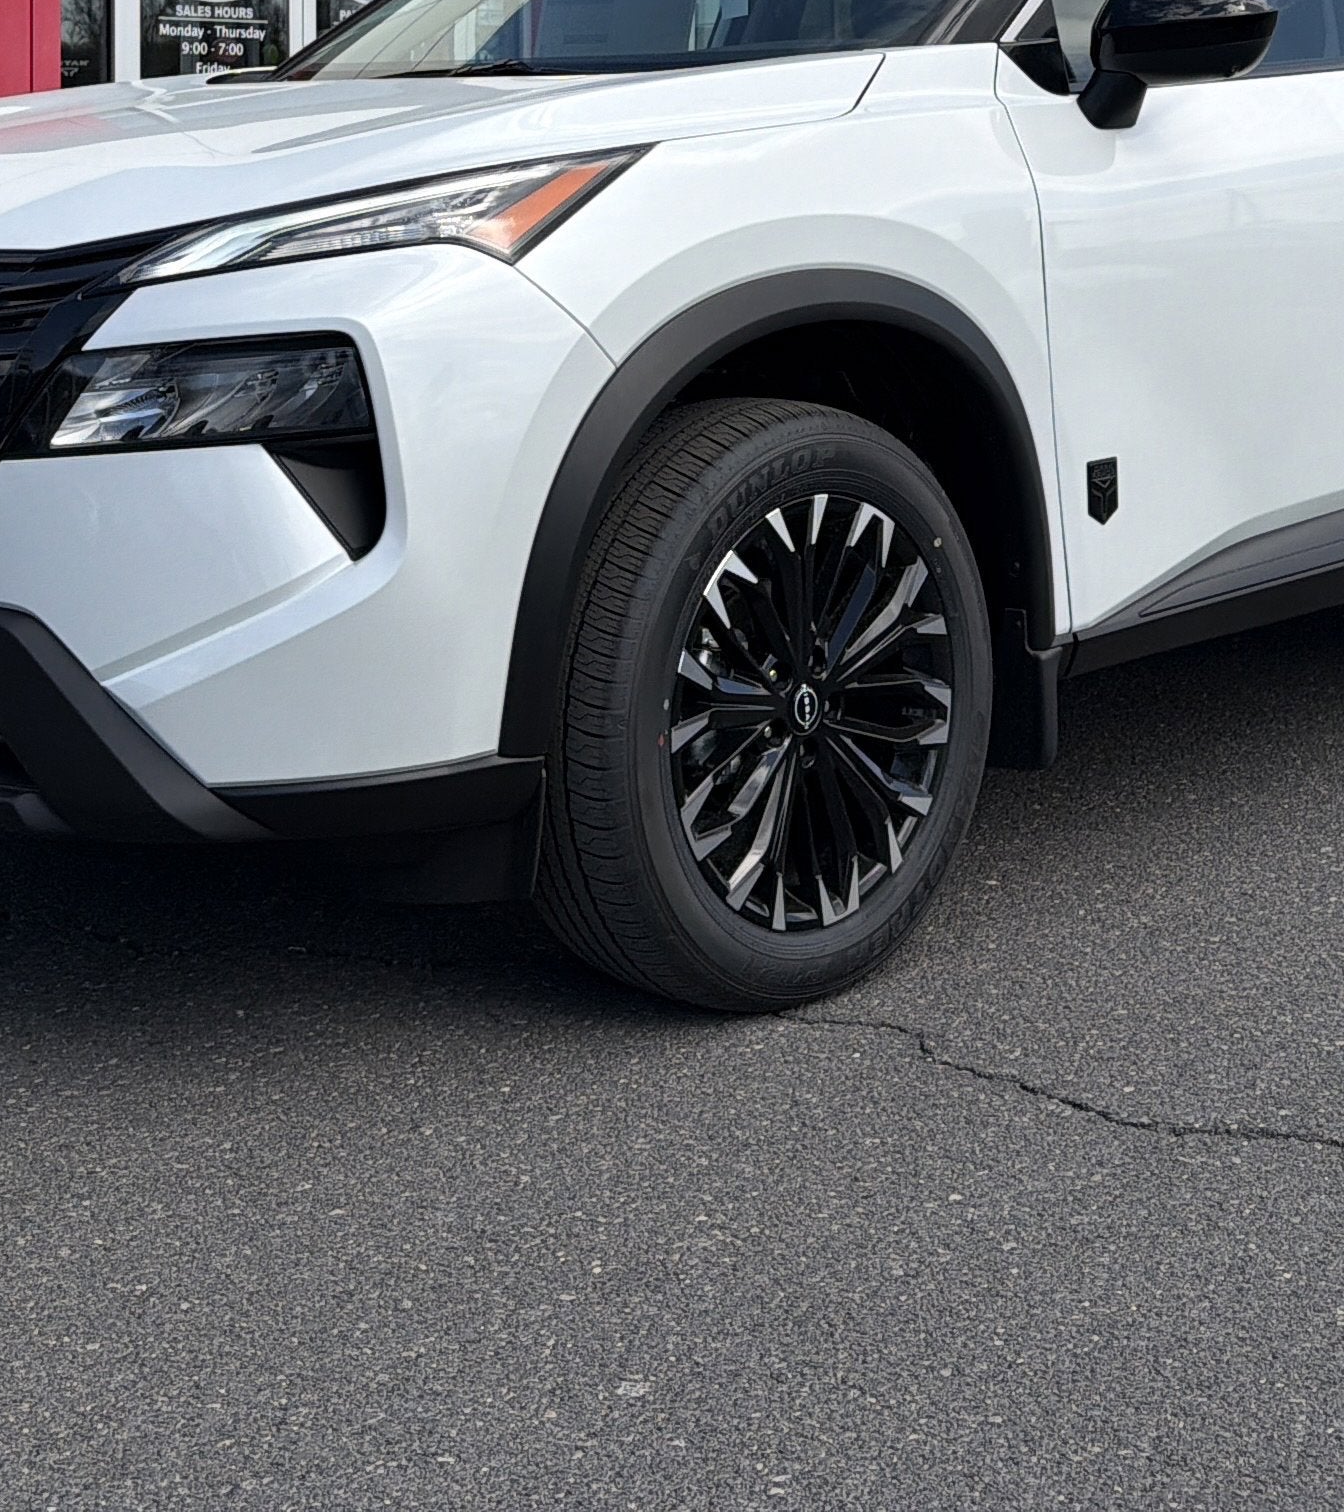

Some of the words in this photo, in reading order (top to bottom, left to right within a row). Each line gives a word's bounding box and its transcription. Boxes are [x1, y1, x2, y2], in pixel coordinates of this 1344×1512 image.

[175, 4, 211, 18] SALES
[214, 6, 253, 19] HOURS
[159, 23, 204, 39] Monday
[213, 25, 266, 41] Thursday
[181, 42, 208, 55] 9:00
[218, 43, 244, 56] 7:00
[196, 62, 230, 74] Friday
[708, 448, 836, 540] DUNLOP
